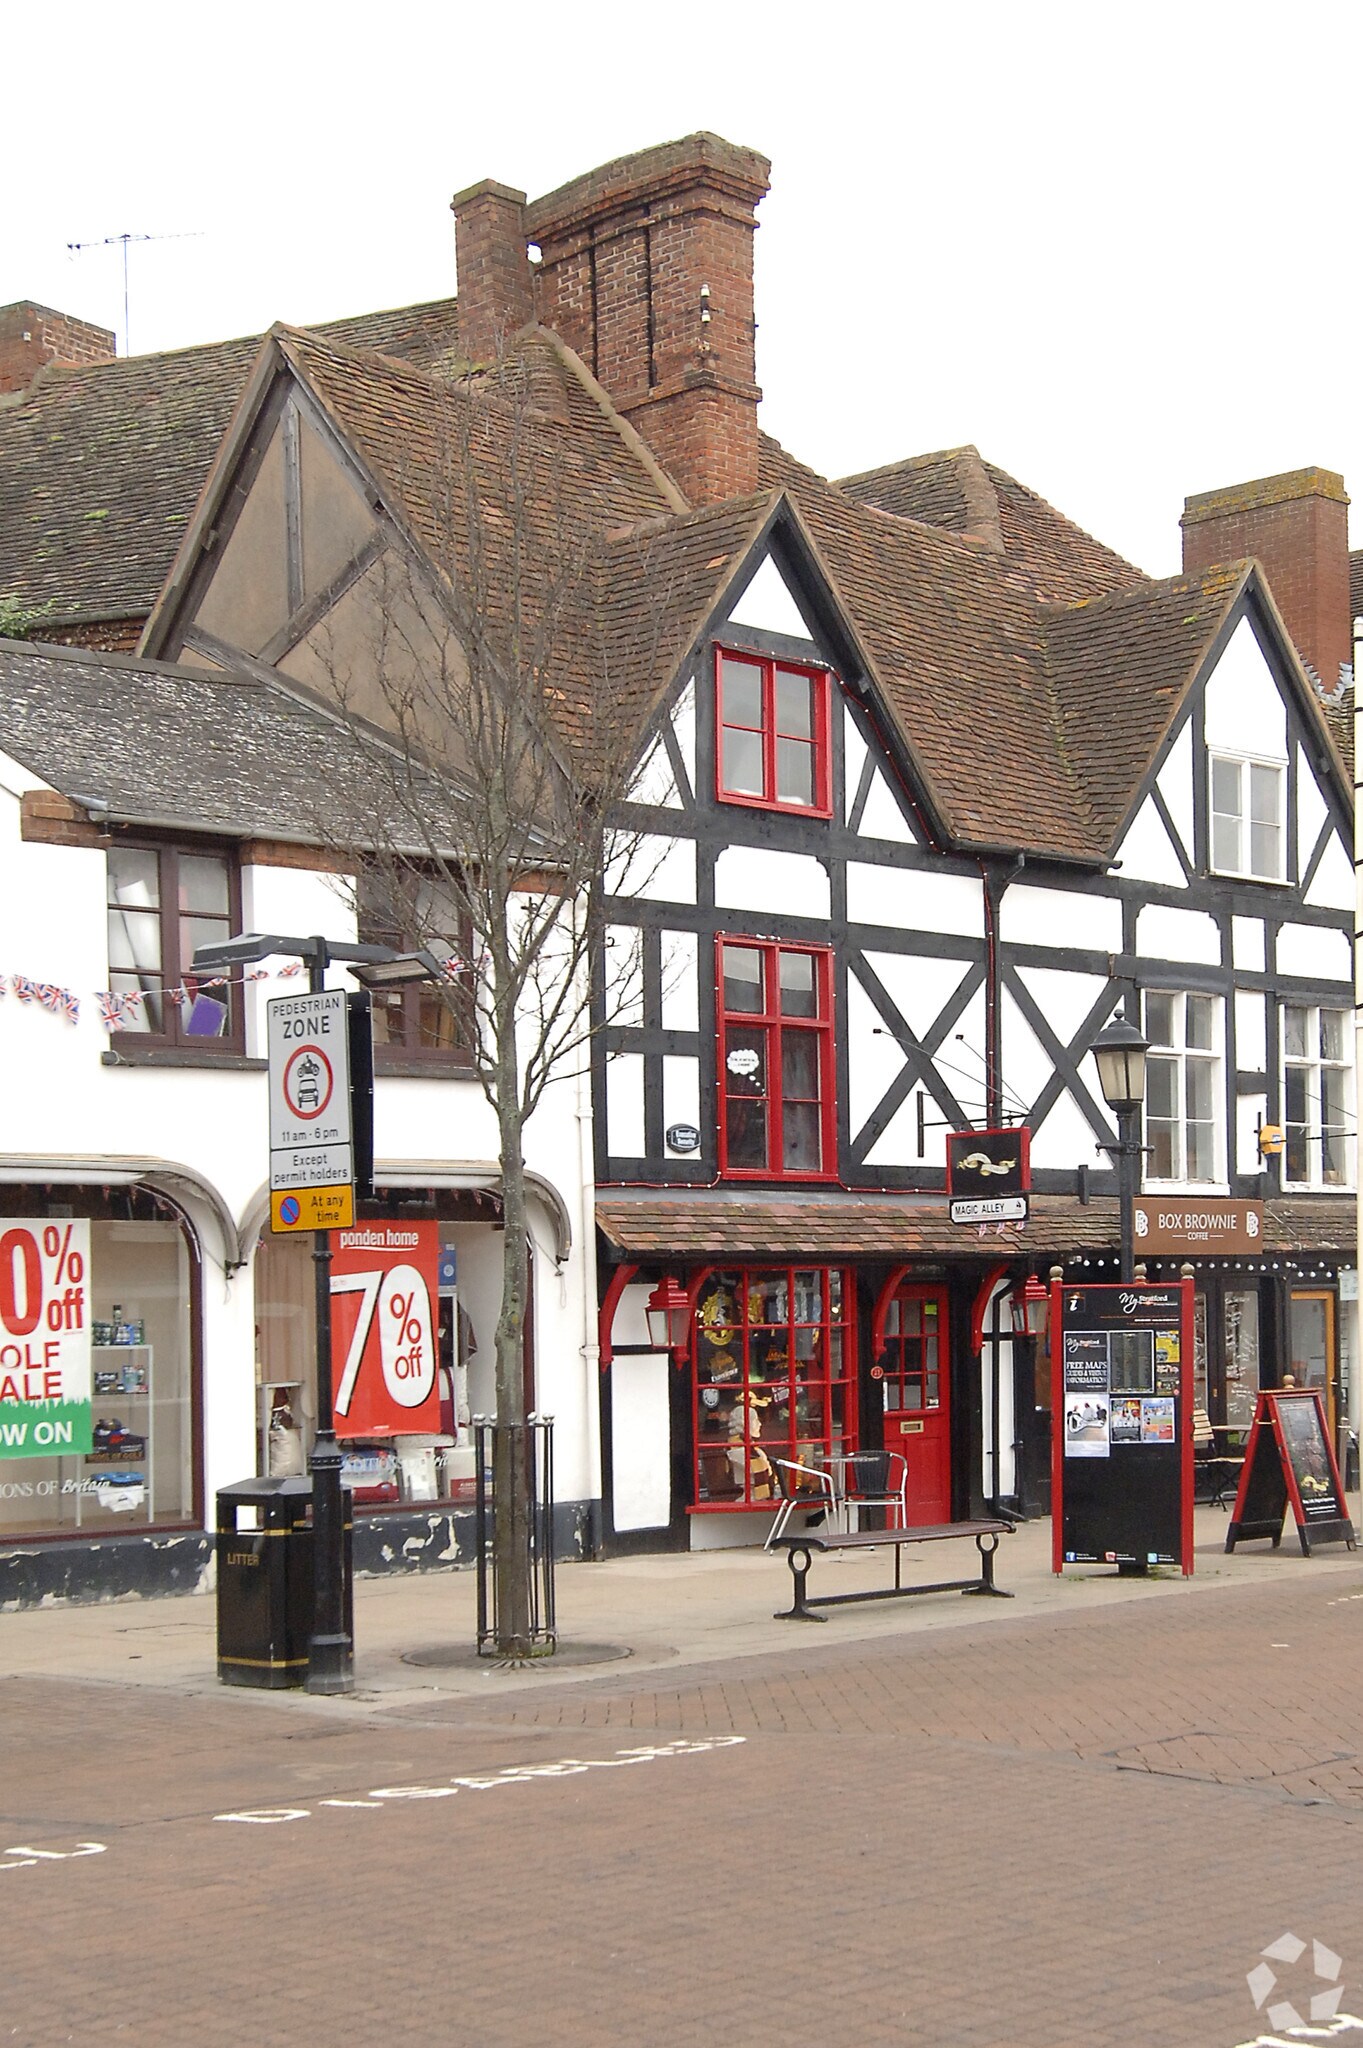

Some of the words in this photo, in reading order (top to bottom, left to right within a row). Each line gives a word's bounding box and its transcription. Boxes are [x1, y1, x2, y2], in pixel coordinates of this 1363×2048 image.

[273, 997, 340, 1017] PEDESTRIAN
[283, 1015, 330, 1039] ZONE
[282, 1131, 290, 1142] 11
[292, 1131, 307, 1141] am
[315, 1128, 321, 1138] 6
[323, 1128, 338, 1140] pm
[293, 1153, 328, 1168] Except
[274, 1170, 307, 1184] permit
[310, 1167, 348, 1180] holders
[311, 1196, 323, 1207] At
[326, 1196, 344, 1208] any
[955, 1204, 979, 1215] MAGIC
[981, 1203, 1005, 1213] ALLEY
[317, 1211, 339, 1222] time
[1158, 1213, 1183, 1229] BOX
[1184, 1213, 1237, 1229] BROWNIE
[340, 1229, 385, 1249] ponden
[386, 1228, 419, 1246] home
[1187, 1231, 1209, 1241] COFFEE
[47, 1287, 84, 1332] off
[1119, 1292, 1138, 1314] My
[394, 1346, 423, 1380] off
[1066, 1361, 1084, 1370] FREE
[1085, 1361, 1107, 1370] MAPS
[34, 1420, 73, 1445] ON
[36, 1480, 59, 1496] OF
[61, 1478, 111, 1494] Britain
[227, 1552, 260, 1566] LITTER
